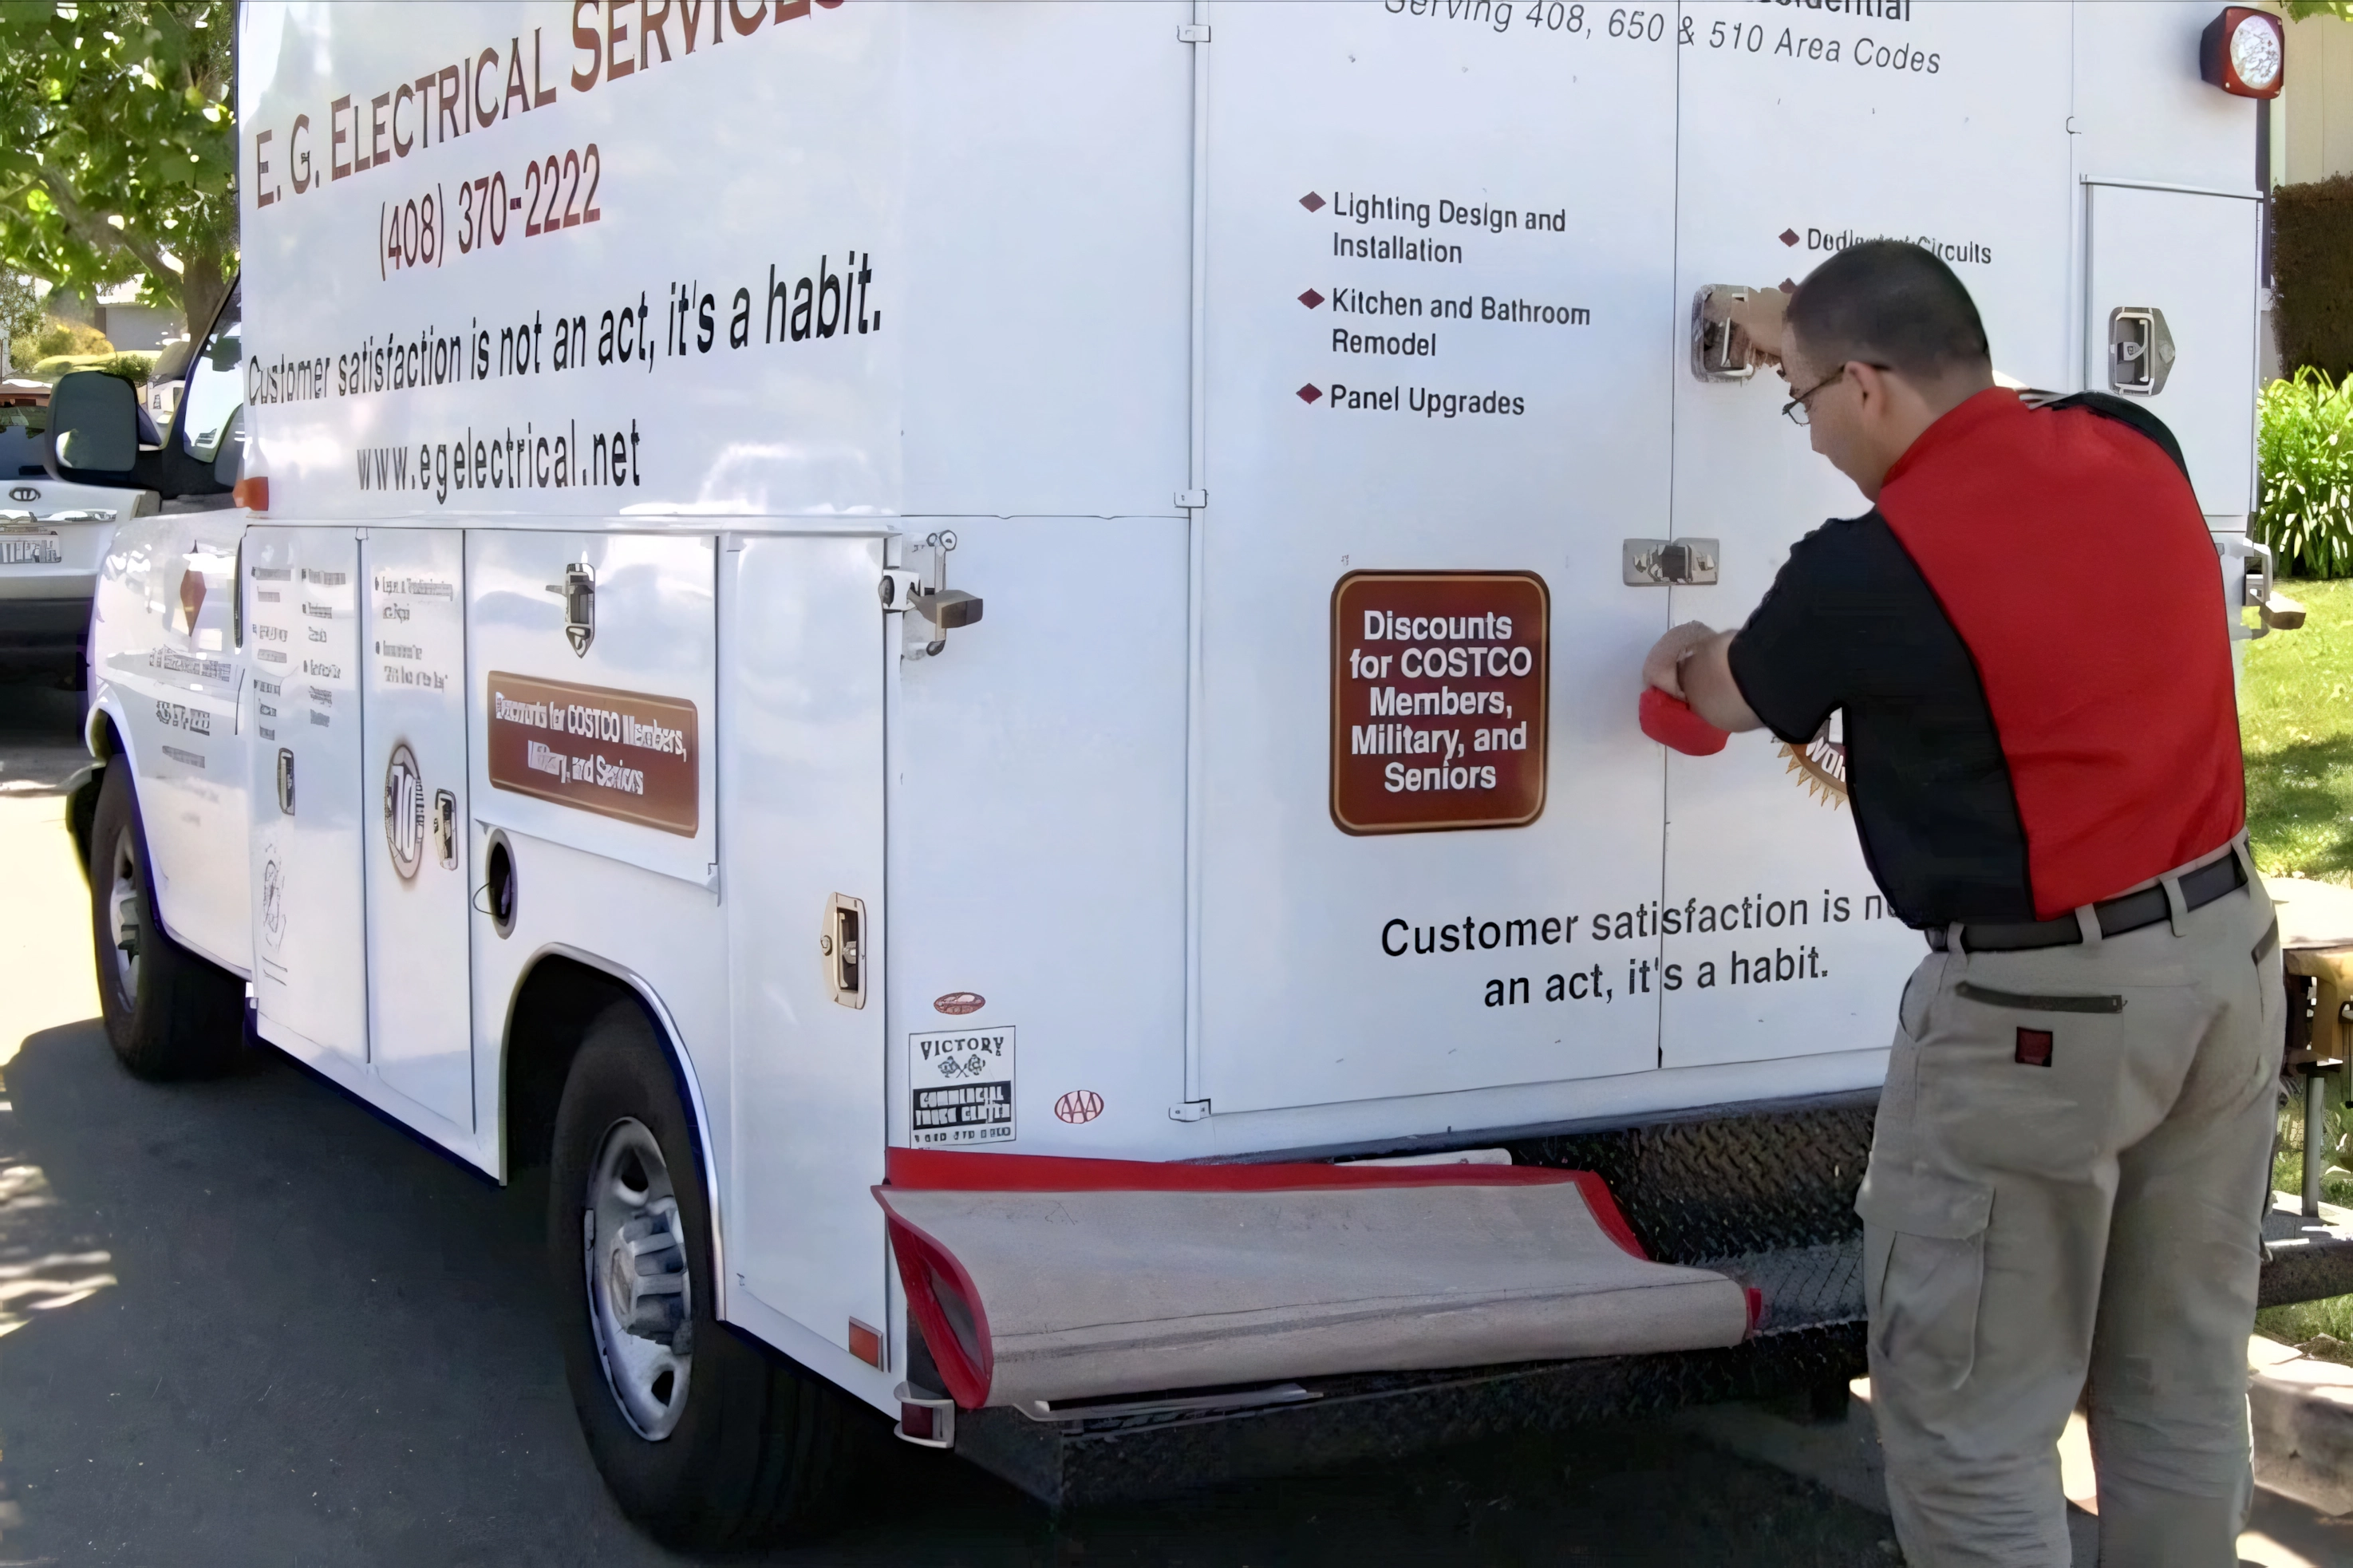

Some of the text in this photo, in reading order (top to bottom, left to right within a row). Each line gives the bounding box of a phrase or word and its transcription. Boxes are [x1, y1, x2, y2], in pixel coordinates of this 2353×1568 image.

[1525, 0, 1592, 40] 408,
[1608, 8, 1665, 41] 650
[1678, 16, 1695, 46] &
[1709, 21, 1763, 53] 510
[1774, 27, 1841, 63] Area
[1854, 38, 1941, 74] Codes
[256, 129, 282, 210] E.
[290, 113, 320, 195] G.
[330, 26, 557, 182] ELECTRICAL
[379, 144, 602, 282] (408) 370-2222
[1334, 192, 1566, 233] Lighting Design and
[1333, 232, 1463, 263] Installation
[1332, 287, 1591, 326] Kitchen and Bathroom
[248, 250, 882, 406] Customer satisfaction is not an act, it's a habit.
[1332, 328, 1436, 356] Remodel
[1330, 384, 1526, 418] Panel Upgrades
[356, 418, 640, 506] www.egelectrical.net
[1364, 610, 1513, 641] Discounts
[1349, 646, 1533, 679] for COSTCO
[1369, 685, 1513, 719] Members,
[567, 704, 620, 743] COSTCO
[1351, 721, 1527, 762] Military, and
[1384, 761, 1497, 793] Seniors
[1380, 913, 1579, 958] Customer
[1590, 891, 1809, 942] satisfaction
[1822, 888, 1851, 924] is
[1483, 945, 1829, 1008] an act, it's a habit.
[920, 1036, 1005, 1061] VICTORY
[1056, 1090, 1103, 1124] AAA
